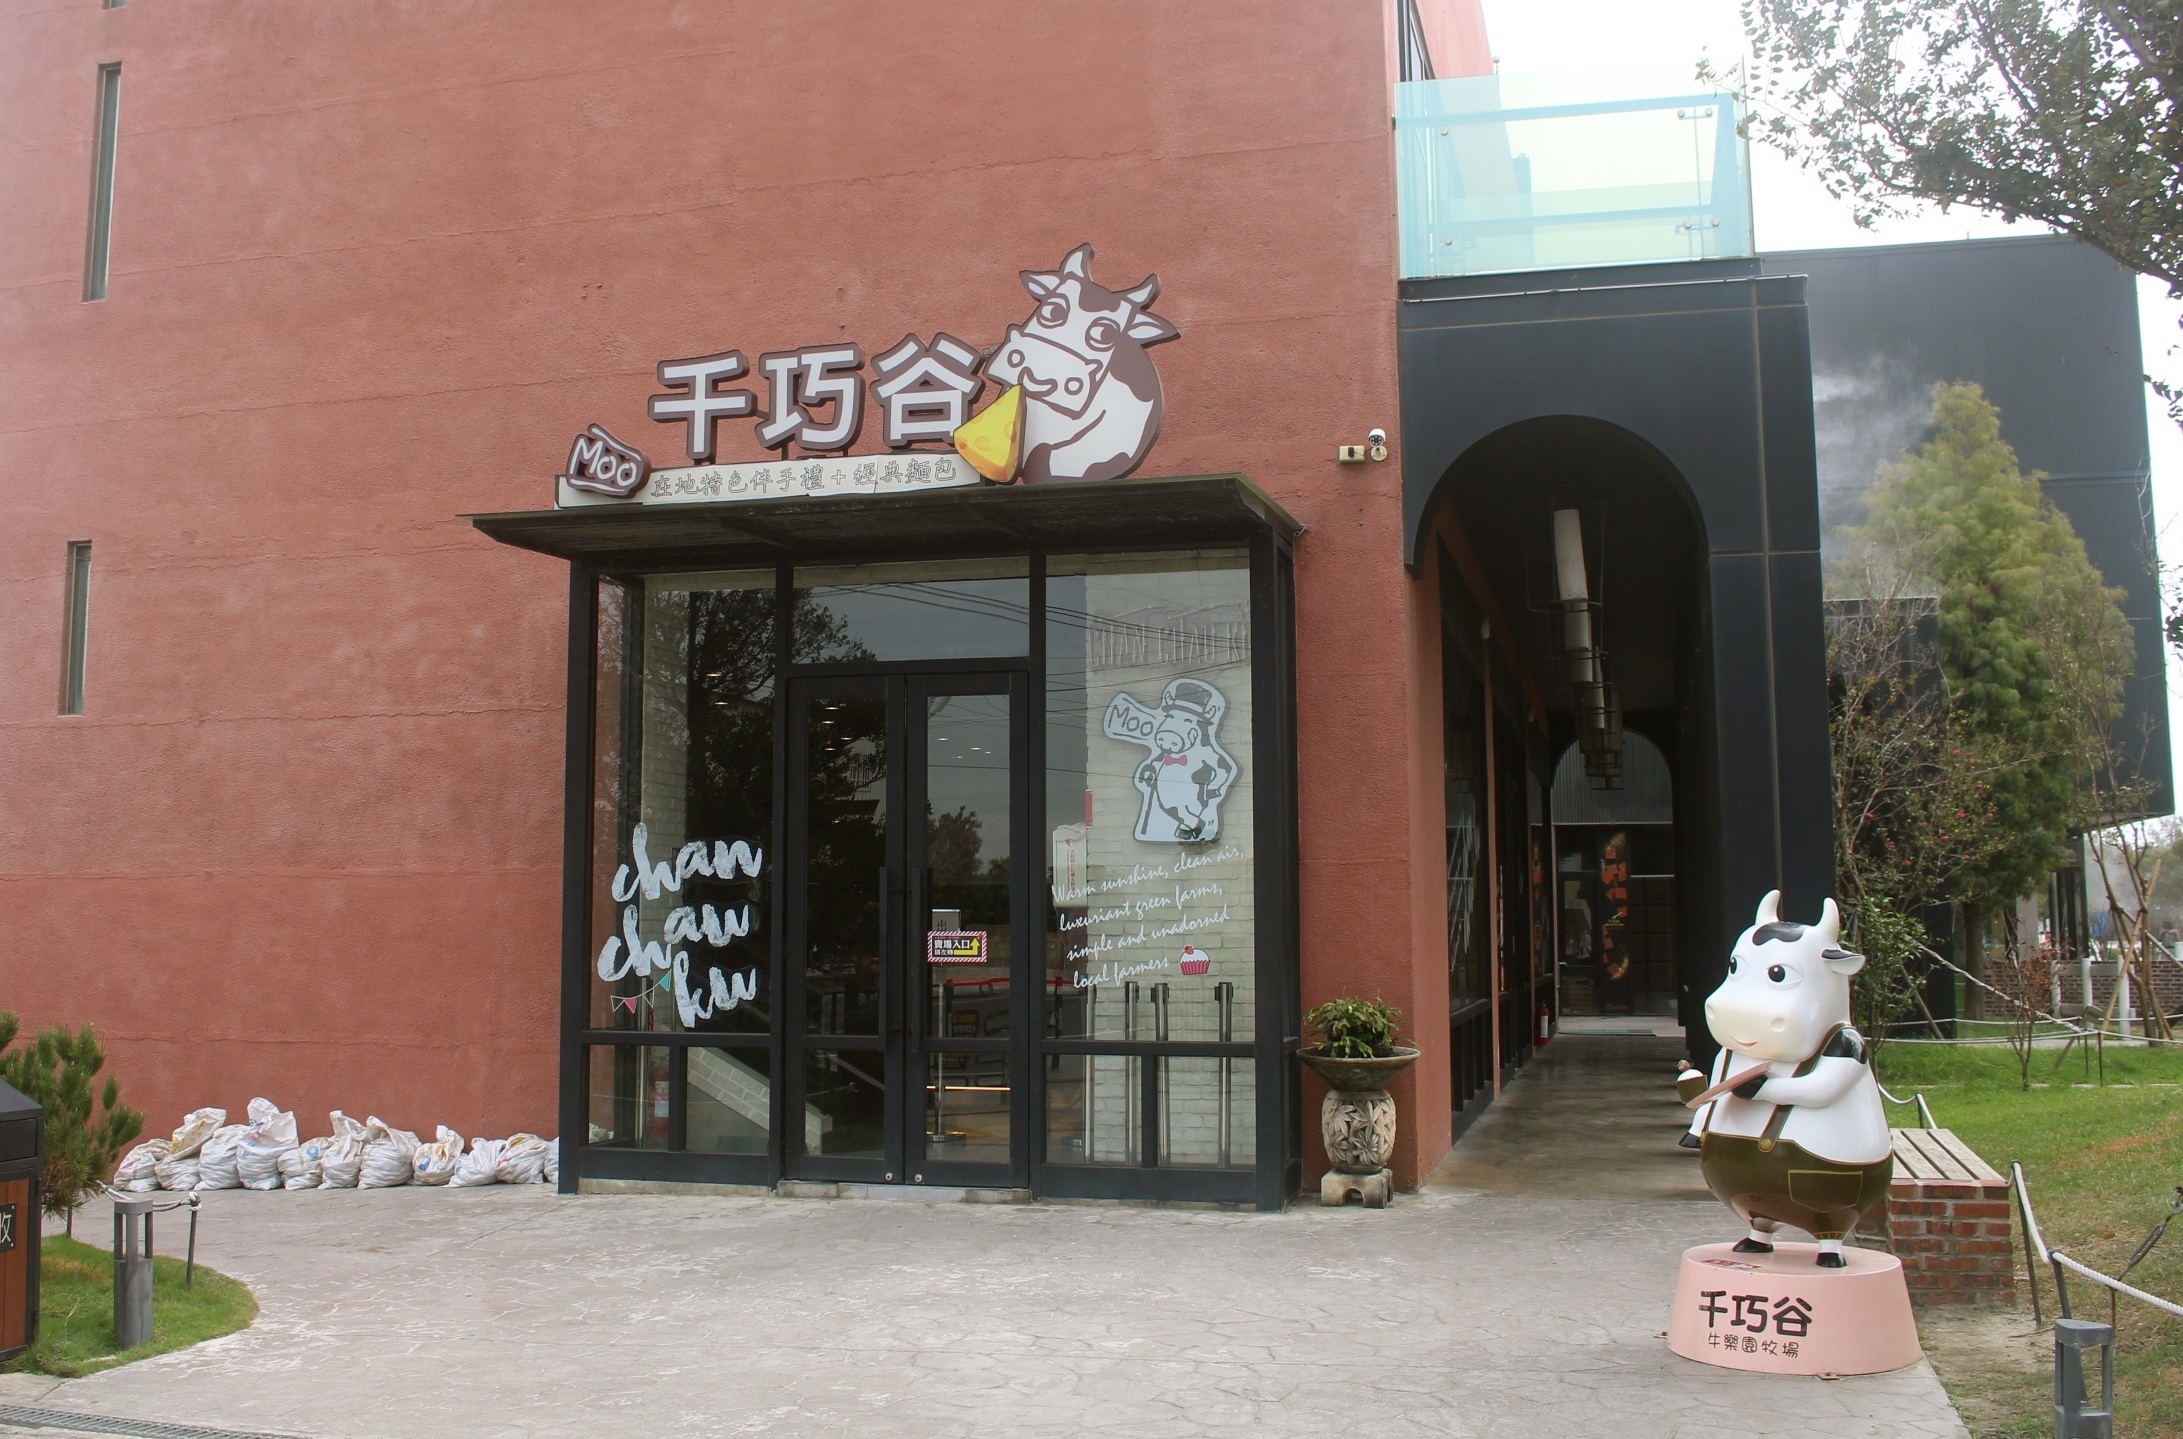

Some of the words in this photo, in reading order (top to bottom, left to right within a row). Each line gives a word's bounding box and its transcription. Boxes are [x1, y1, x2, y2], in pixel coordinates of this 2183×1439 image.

[648, 339, 976, 454] 千巧谷
[611, 822, 762, 902] chan
[1052, 884, 1095, 903] Warm
[1100, 864, 1168, 892] sunshine,
[1173, 852, 1212, 873] clean
[1216, 845, 1244, 860] air,
[1060, 900, 1131, 931] luxuriant
[1135, 895, 1171, 920] green
[1175, 883, 1223, 910] farms,
[934, 939, 970, 949] 賣場入口
[1066, 934, 1113, 961] simple
[1117, 925, 1146, 947] and
[1151, 904, 1230, 939] unadorned
[1073, 963, 1109, 988] local
[1114, 956, 1169, 986] farmers
[1699, 1290, 1813, 1337] 千巧谷
[1708, 1332, 1800, 1359] 牛樂園牧場
